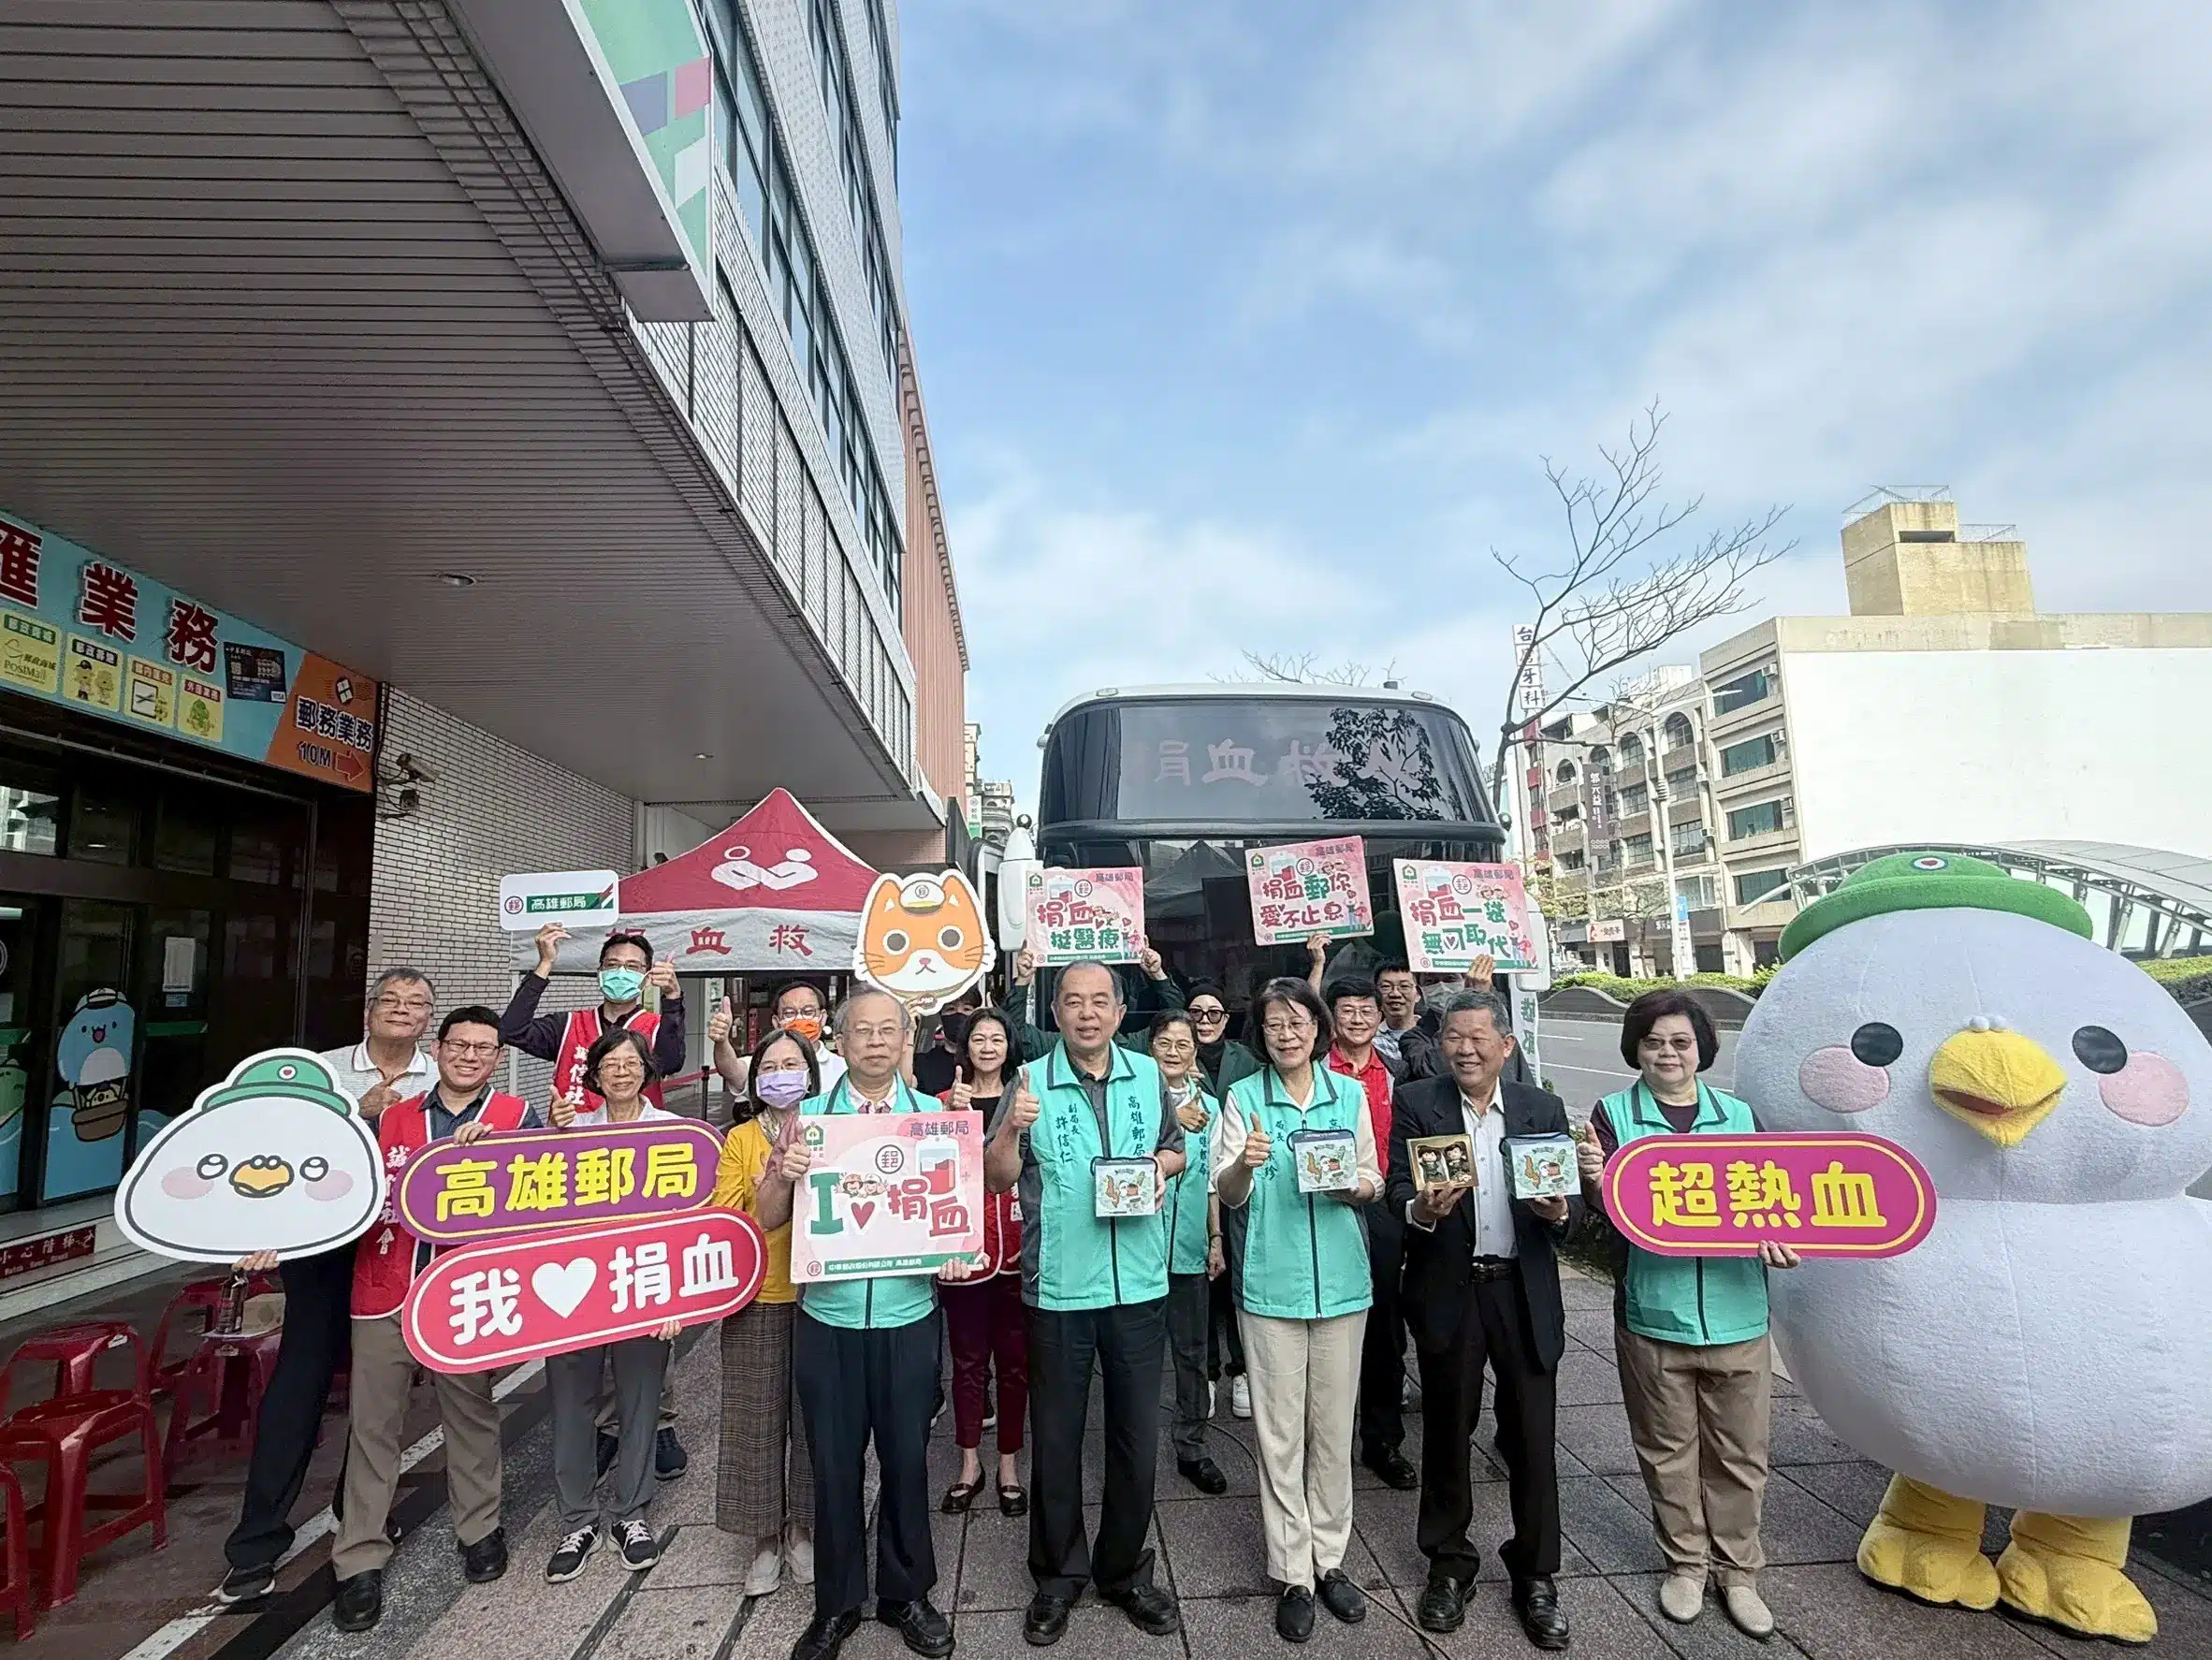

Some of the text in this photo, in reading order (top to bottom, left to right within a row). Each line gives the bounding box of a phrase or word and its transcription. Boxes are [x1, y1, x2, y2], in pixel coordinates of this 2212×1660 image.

[297, 695, 373, 752] 郵務業務
[298, 741, 332, 767] 10M
[531, 896, 587, 910] 高雄郵局
[1261, 873, 1351, 900] 捐血郵你
[1037, 900, 1094, 927] 捐血
[1259, 901, 1344, 928] 愛不止息
[1409, 896, 1507, 926] 捐血一袋
[1050, 927, 1120, 951] 挺醫療
[1421, 923, 1511, 959] 無可取代
[910, 1120, 969, 1136] 高雄郵局
[1069, 1103, 1080, 1135] 副局長
[1128, 1096, 1145, 1157] 高雄郵局
[1055, 1115, 1073, 1164] 許信仁
[1199, 1128, 1207, 1176] 雄郵局
[435, 1143, 698, 1222] 高雄郵局
[1648, 1159, 1887, 1229] 超熱血
[887, 1177, 970, 1238] 捐血
[448, 1232, 739, 1347] 我 捐血
